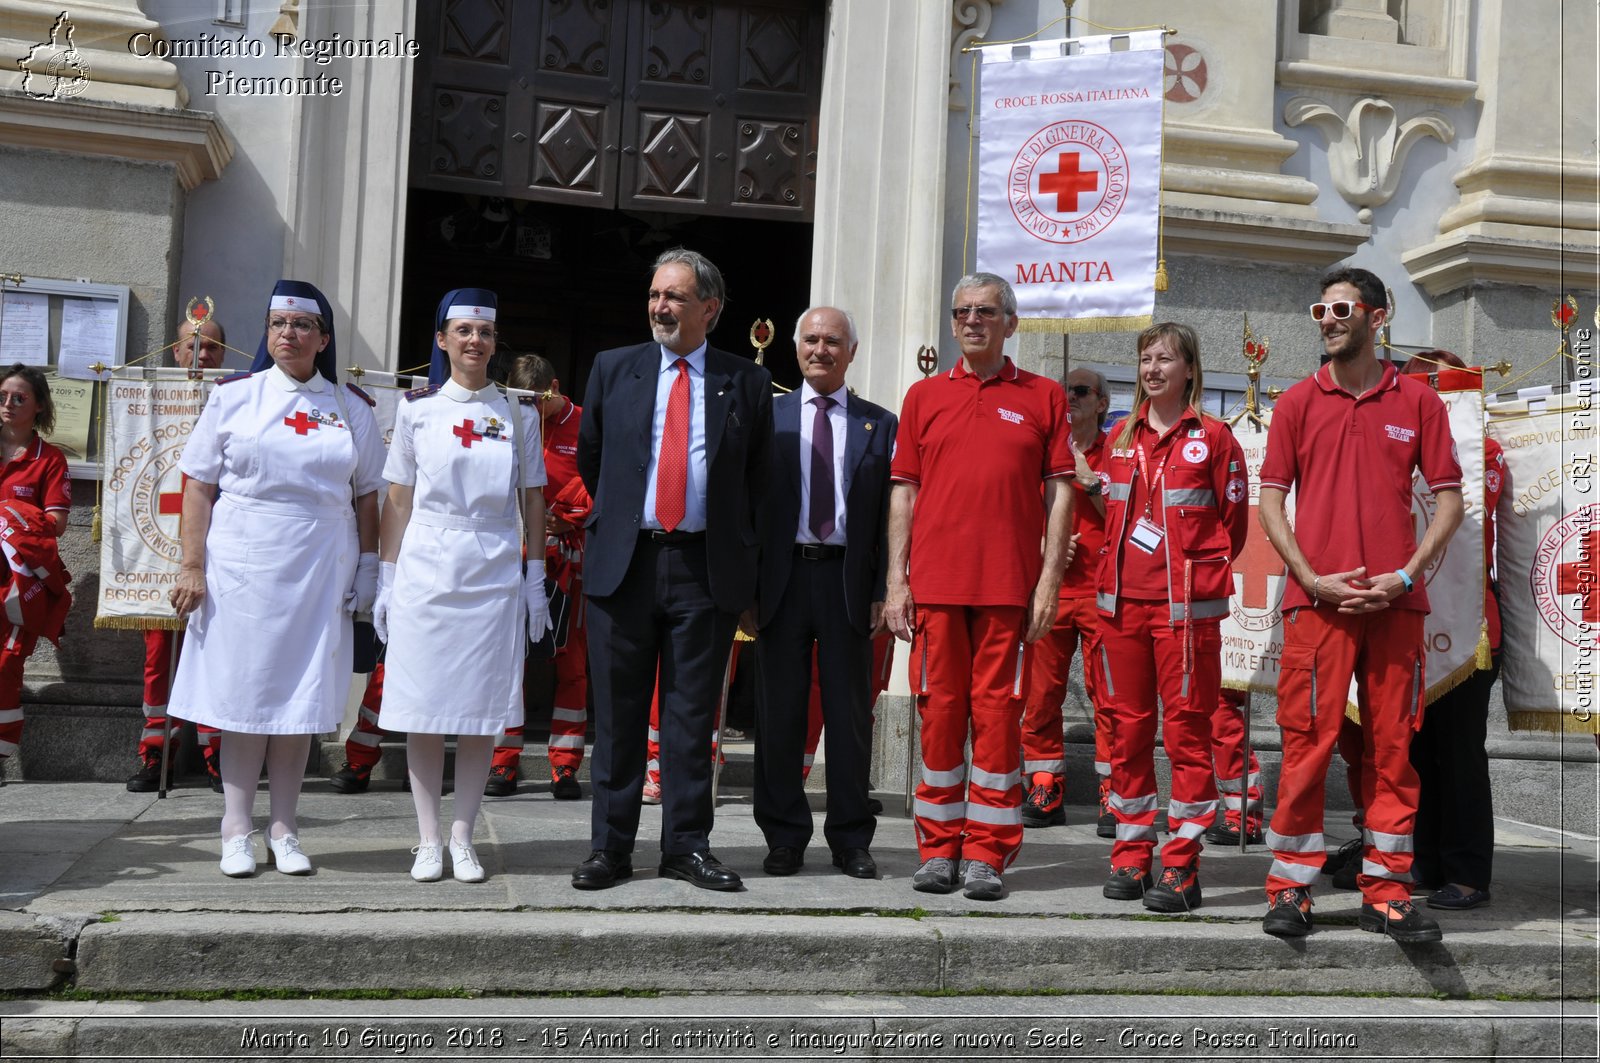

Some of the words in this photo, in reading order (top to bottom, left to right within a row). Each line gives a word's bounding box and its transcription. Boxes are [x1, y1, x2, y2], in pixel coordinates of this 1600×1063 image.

[994, 95, 1038, 109] CROCE
[1041, 92, 1084, 105] ROSSA
[1087, 87, 1151, 101] ITALIANA
[1029, 137, 1047, 156] DI
[1046, 125, 1105, 149] GINEVRA
[1103, 146, 1120, 164] 22
[1013, 153, 1058, 237] CONVENZIONE
[1099, 163, 1125, 218] AGOSTO
[1075, 214, 1103, 237] 1864
[1015, 261, 1115, 285] MANTA
[1508, 432, 1544, 449] CORPO
[109, 437, 152, 492] CROCE
[1513, 469, 1561, 518] CROCE
[105, 588, 161, 601] BORGO
